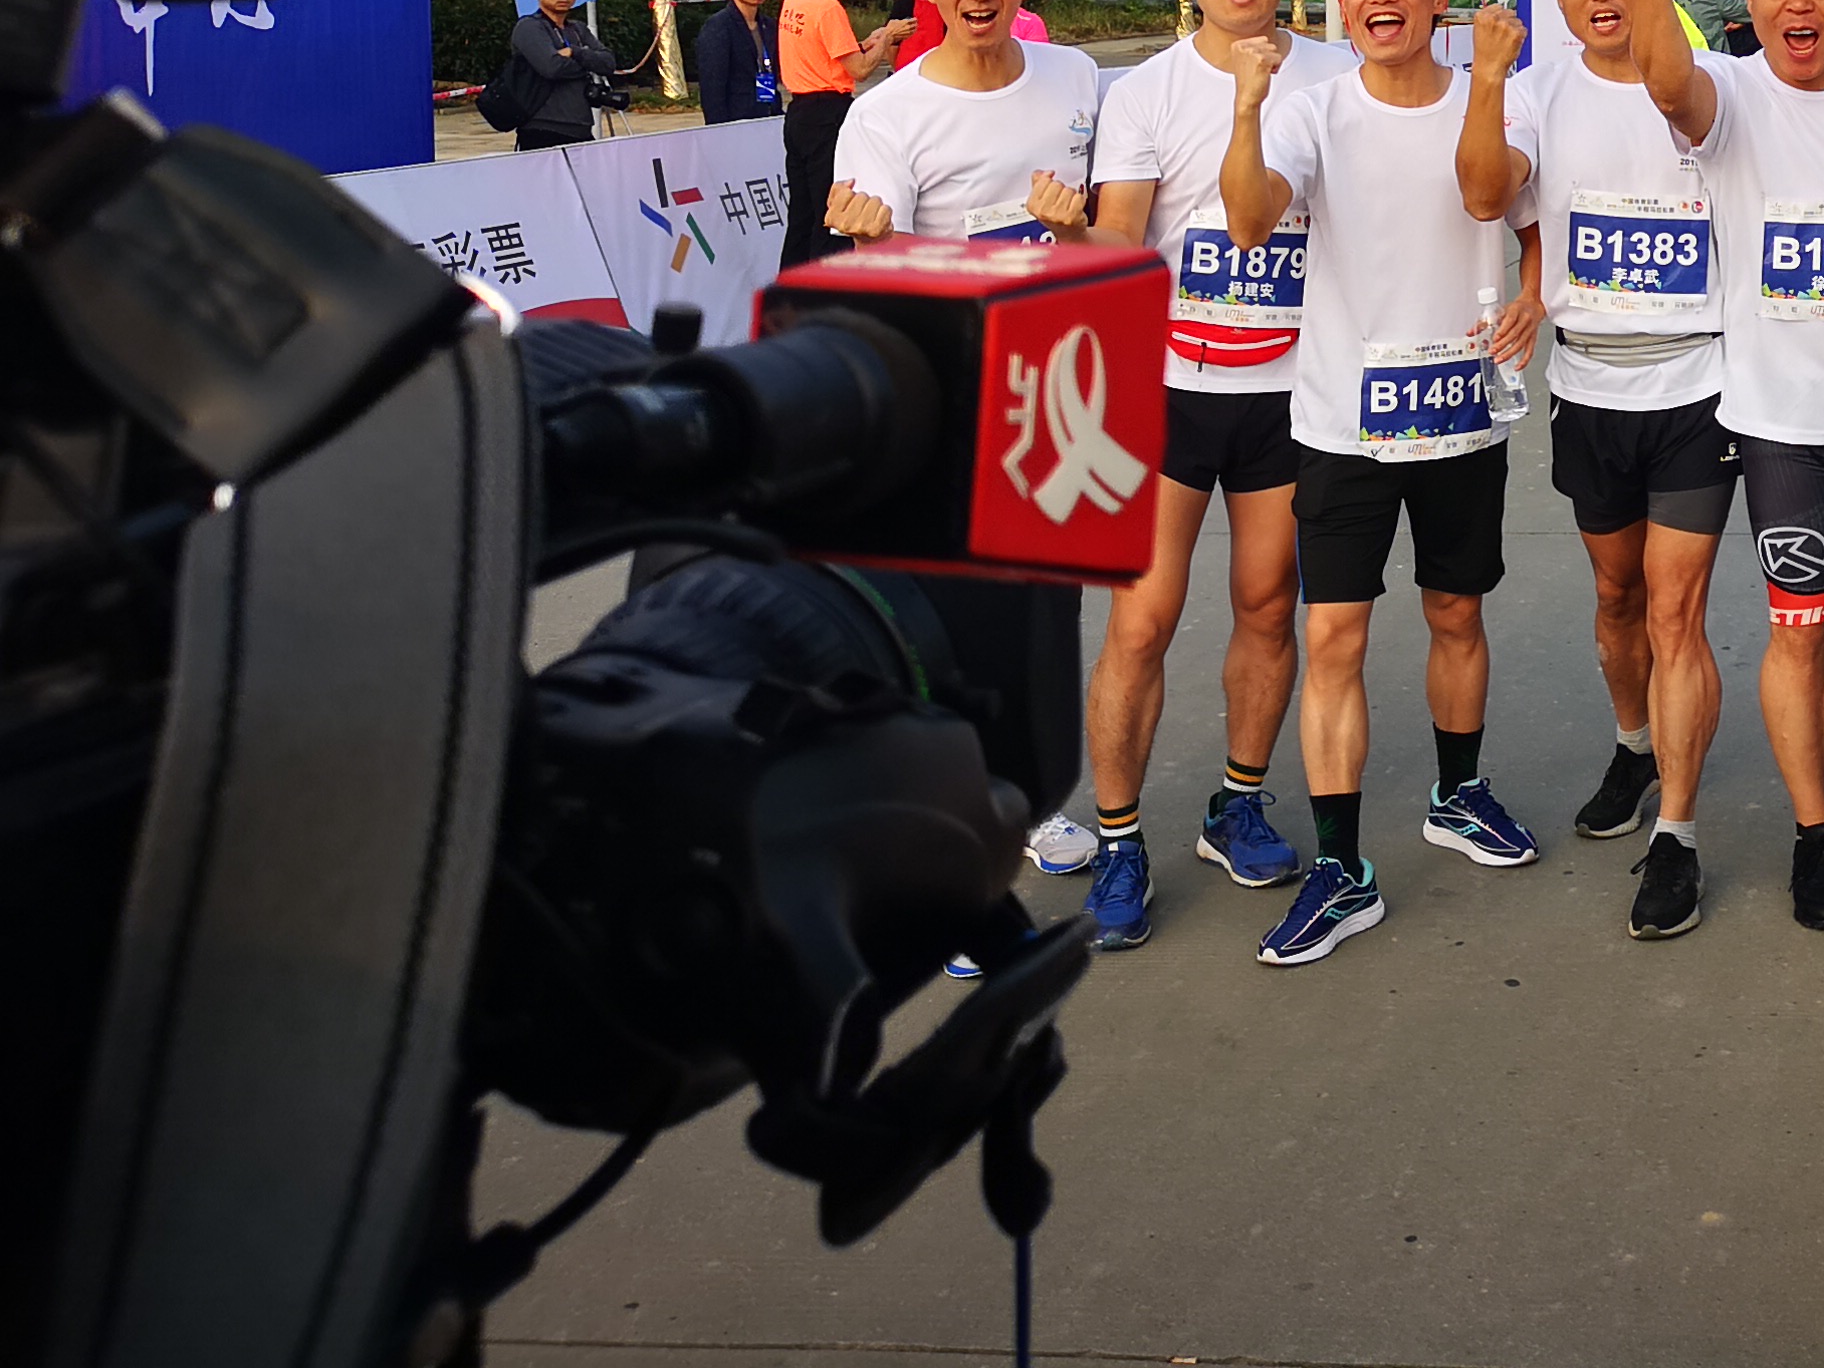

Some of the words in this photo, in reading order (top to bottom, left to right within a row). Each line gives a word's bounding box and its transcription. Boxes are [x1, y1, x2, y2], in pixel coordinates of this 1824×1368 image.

[413, 222, 537, 286] 彩票
[1191, 241, 1307, 280] B1879
[1576, 226, 1699, 267] B1383
[1370, 372, 1482, 414] B1481
